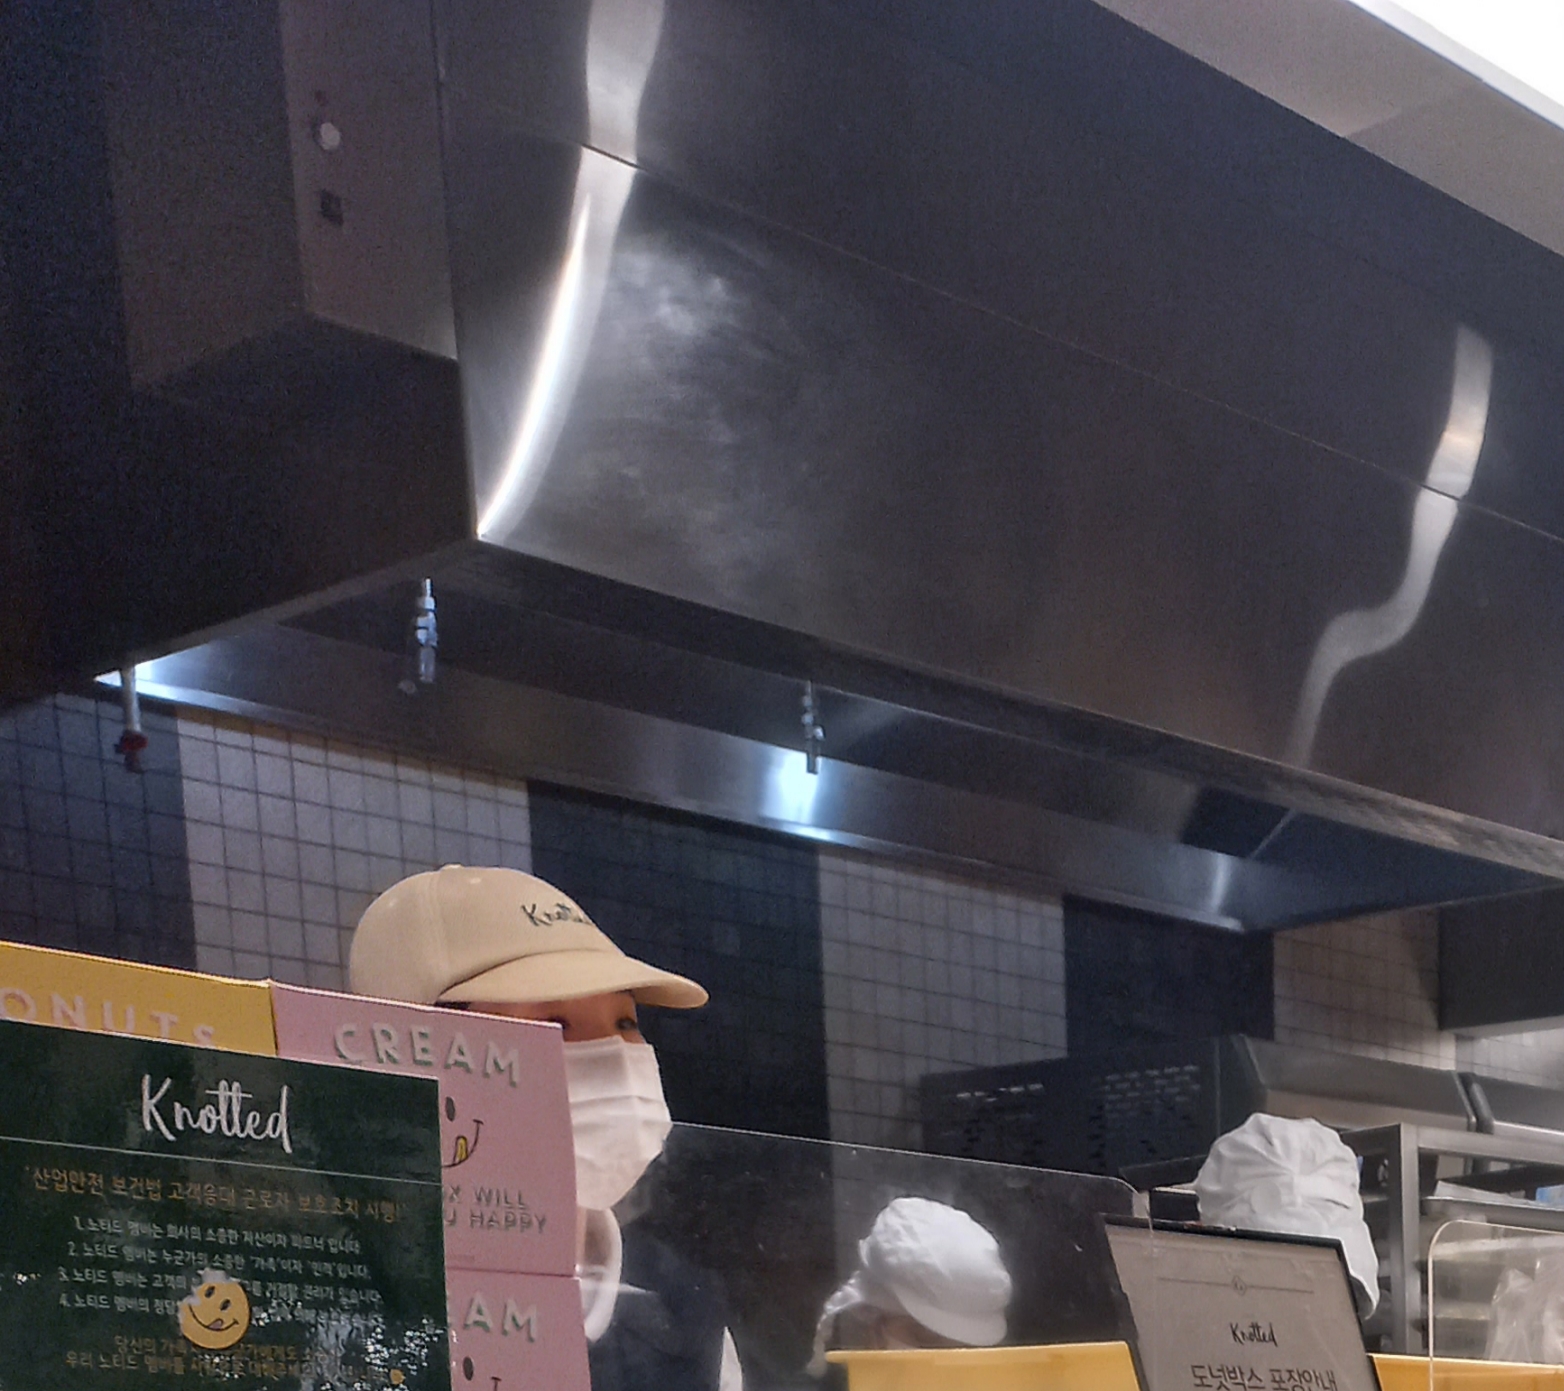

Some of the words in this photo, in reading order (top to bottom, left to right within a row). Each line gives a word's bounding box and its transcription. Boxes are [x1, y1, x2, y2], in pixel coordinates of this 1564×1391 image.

[0, 987, 216, 1048] ONUTS
[335, 1022, 522, 1088] CREAM
[141, 1072, 293, 1154] Knotted
[474, 1186, 528, 1210] WILL
[470, 1210, 548, 1235] HAPPY
[1229, 1322, 1279, 1348] Knotted
